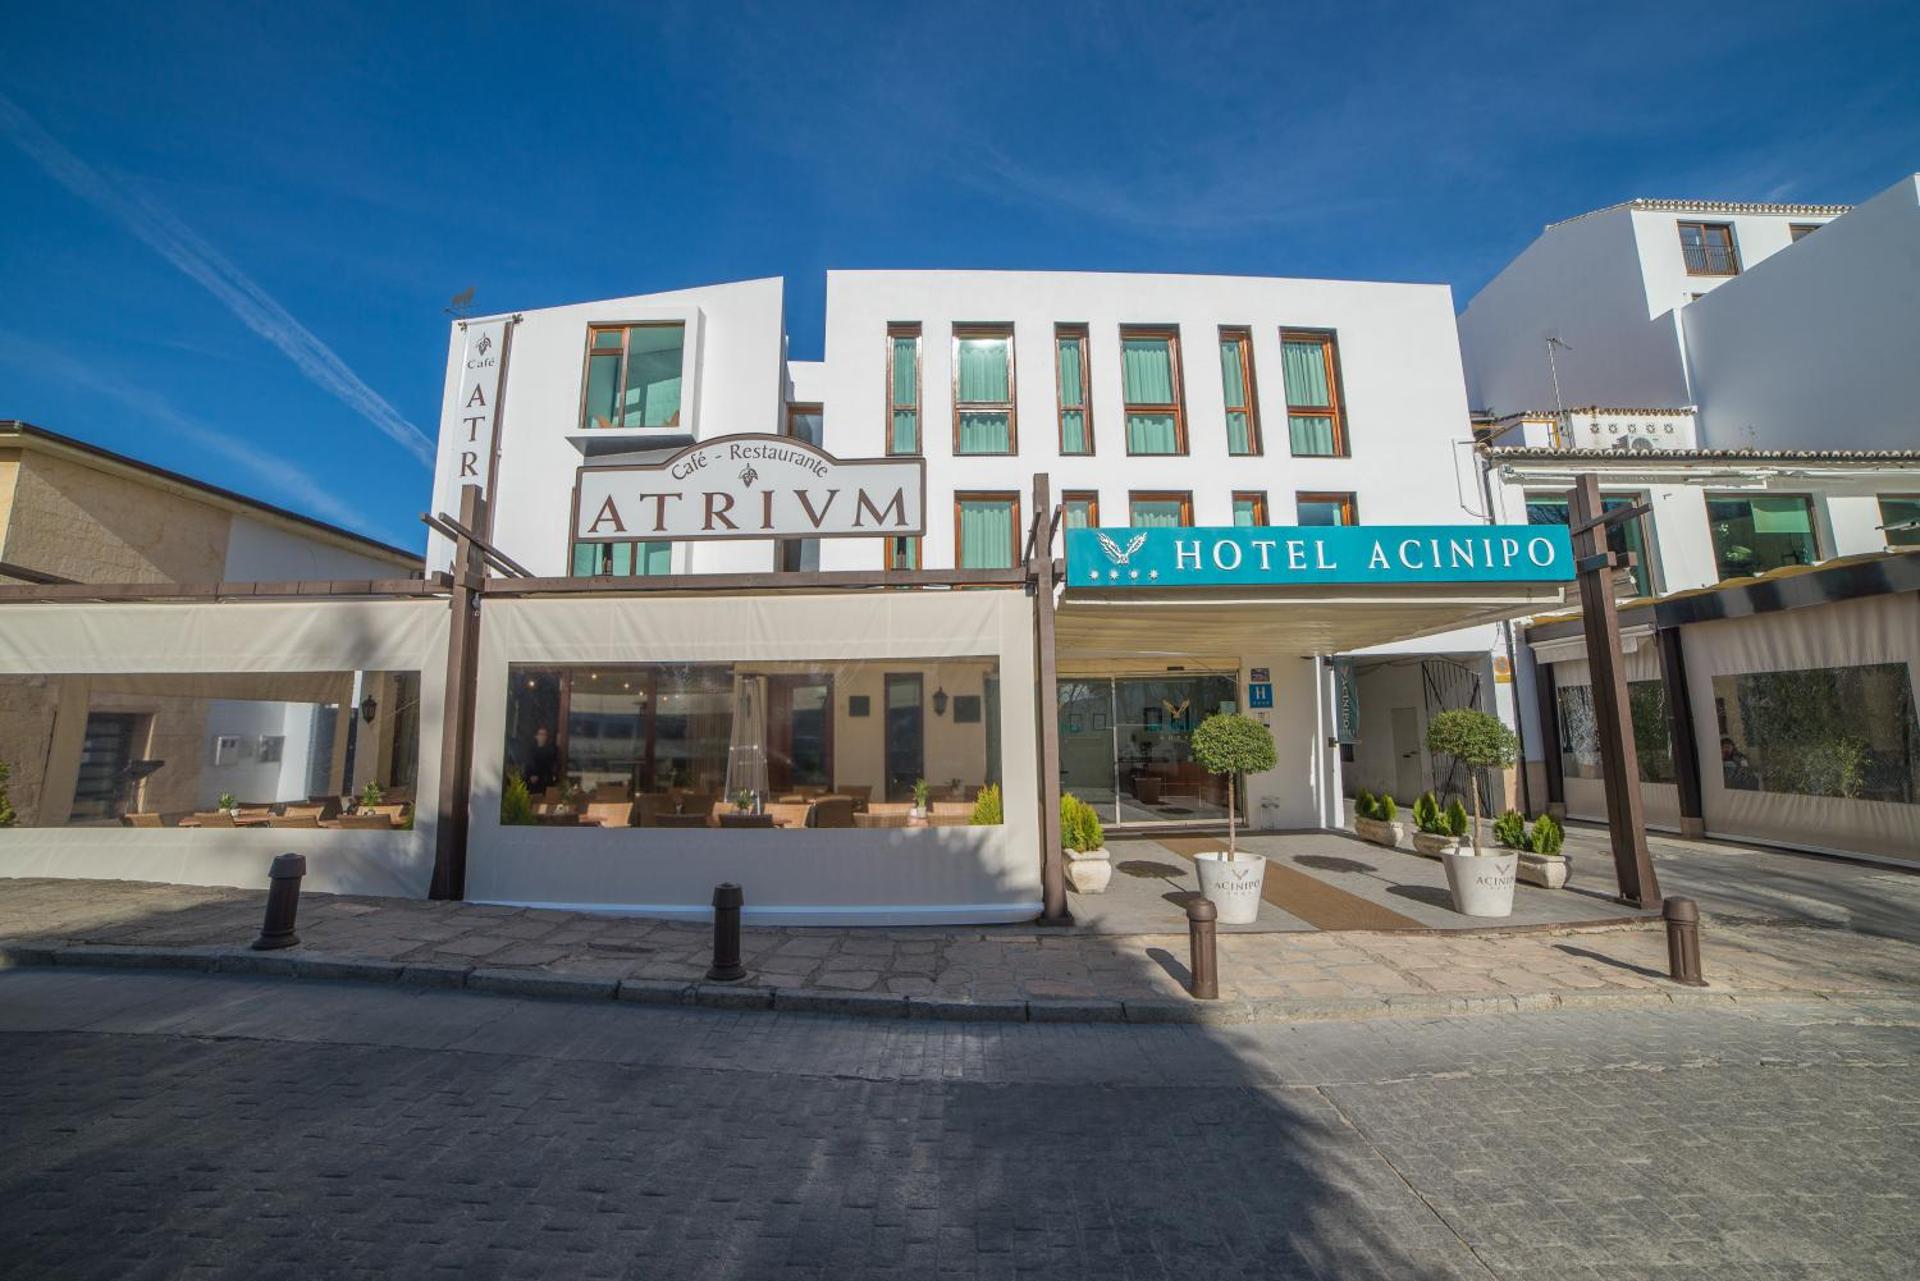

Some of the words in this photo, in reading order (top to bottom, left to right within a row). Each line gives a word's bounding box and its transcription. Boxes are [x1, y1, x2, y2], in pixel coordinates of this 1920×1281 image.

[466, 357, 496, 370] Café
[671, 450, 709, 481] Café
[730, 443, 829, 478] Restaurante
[587, 486, 909, 533] ATRIVM
[1174, 539, 1338, 571] HOTEL
[1368, 538, 1556, 570] ACINIPO
[1215, 879, 1260, 891] ACINIPO
